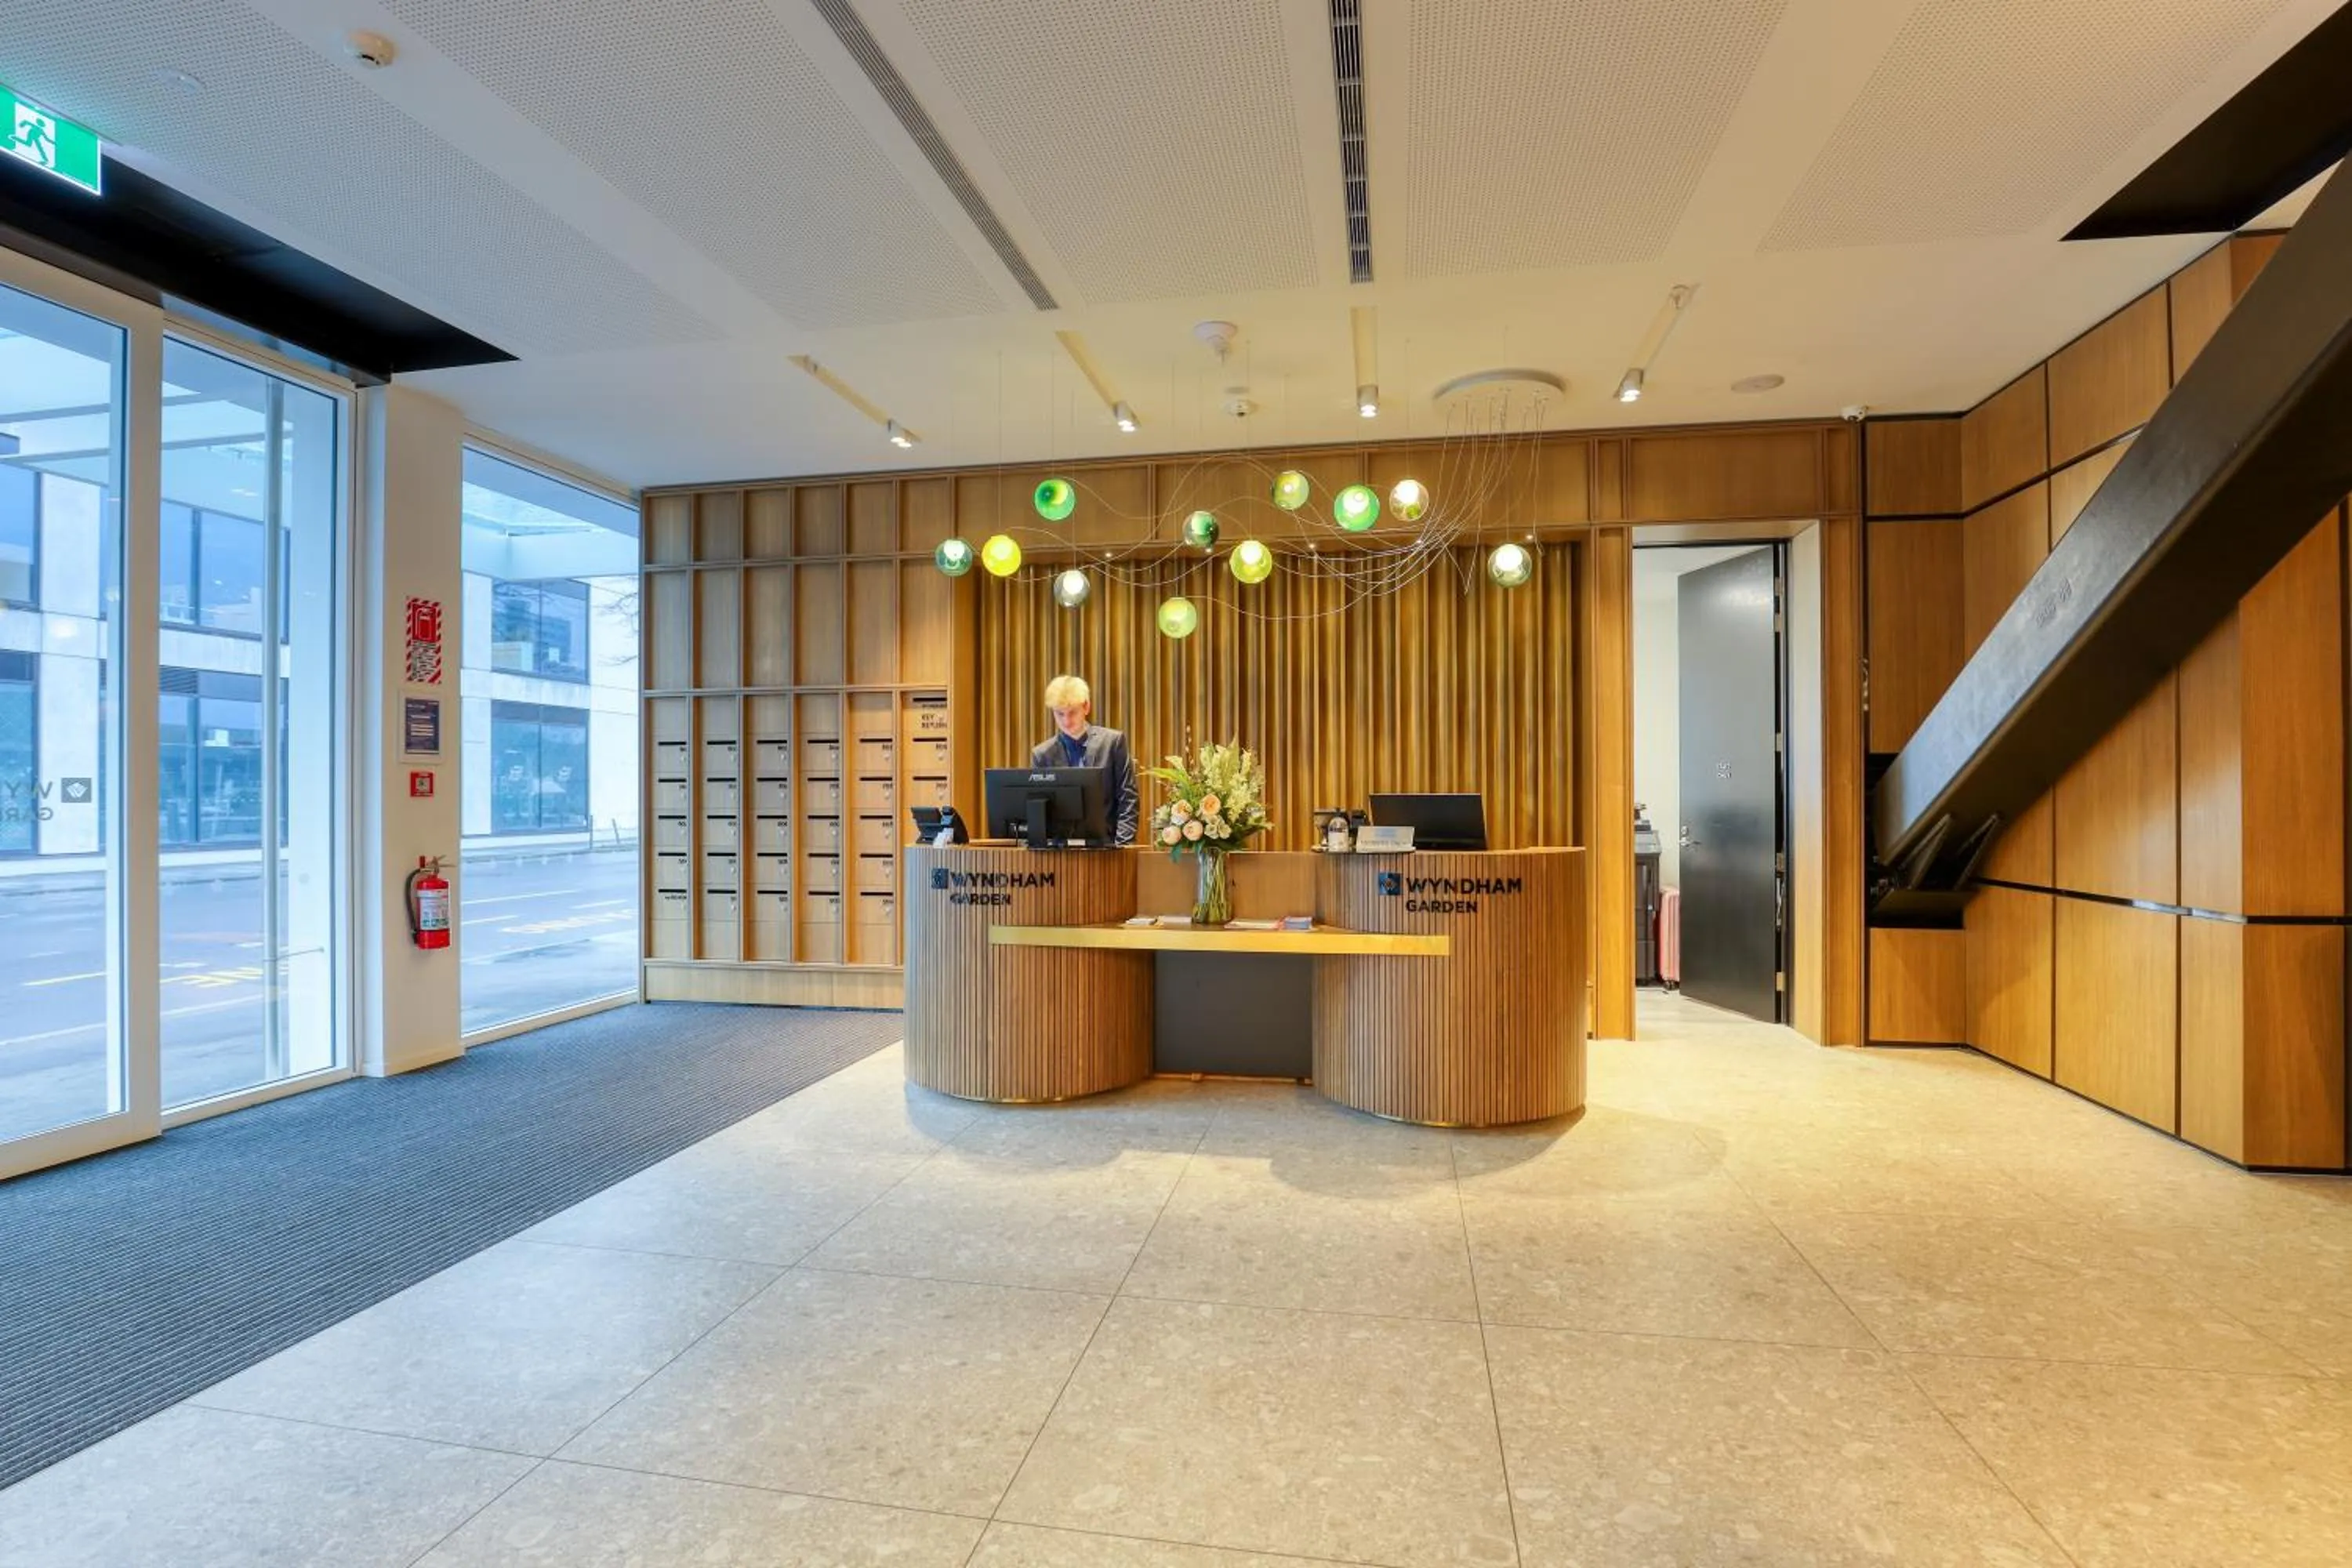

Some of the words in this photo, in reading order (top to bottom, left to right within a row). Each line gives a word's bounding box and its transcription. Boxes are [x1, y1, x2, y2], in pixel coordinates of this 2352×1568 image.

[950, 872, 1054, 887] WYNDHAM
[1406, 877, 1522, 895] WYNDHAM
[949, 893, 1011, 905] GARDEN
[1406, 900, 1478, 913] GARDEN
